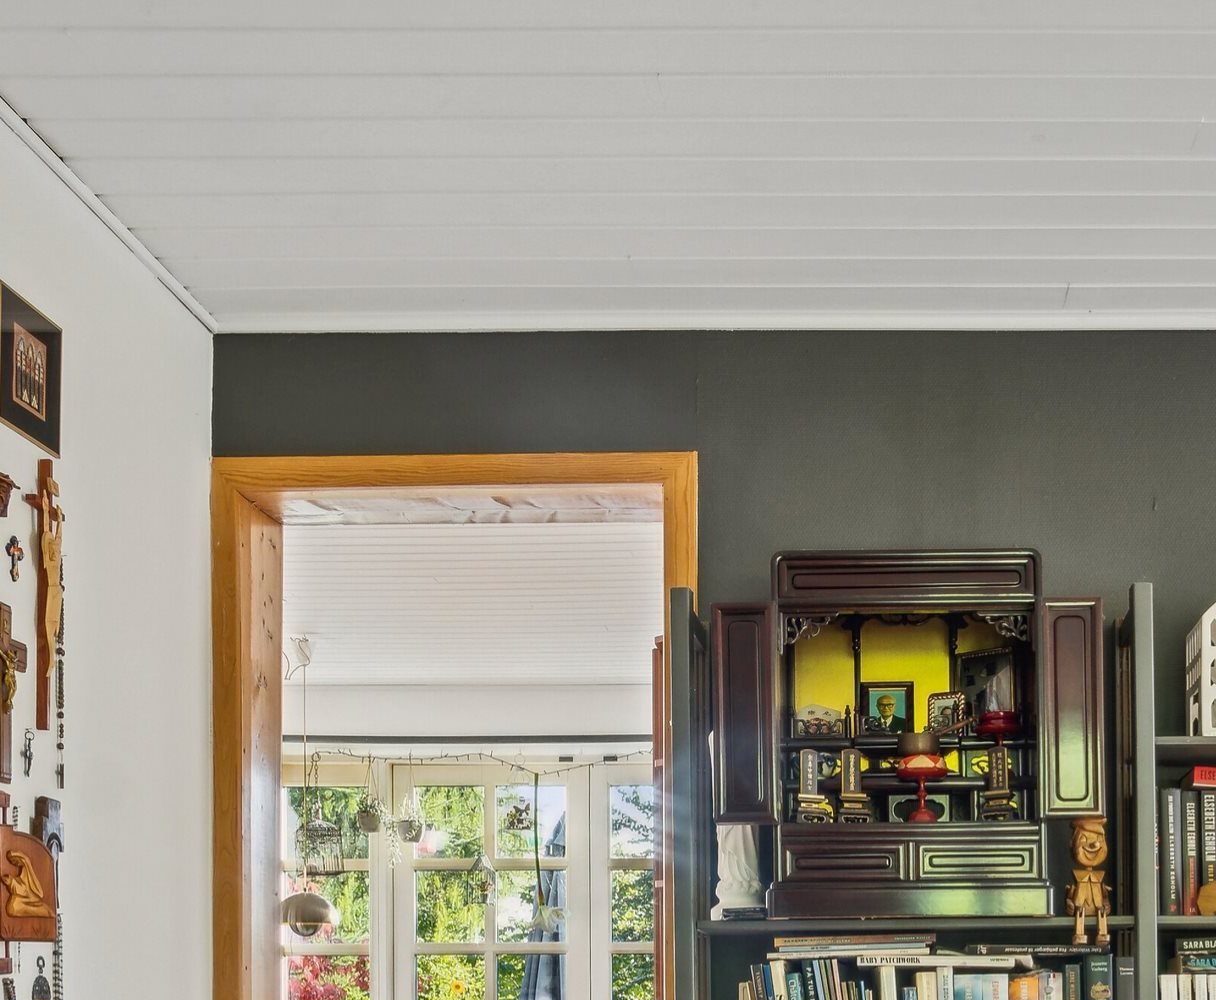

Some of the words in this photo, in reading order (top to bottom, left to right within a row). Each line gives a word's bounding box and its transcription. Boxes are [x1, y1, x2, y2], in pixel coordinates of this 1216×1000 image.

[1204, 795, 1215, 830] ELSEBETH
[1205, 832, 1216, 861] EGHOLM
[1183, 940, 1204, 949] SARA
[807, 980, 815, 995] TUR
